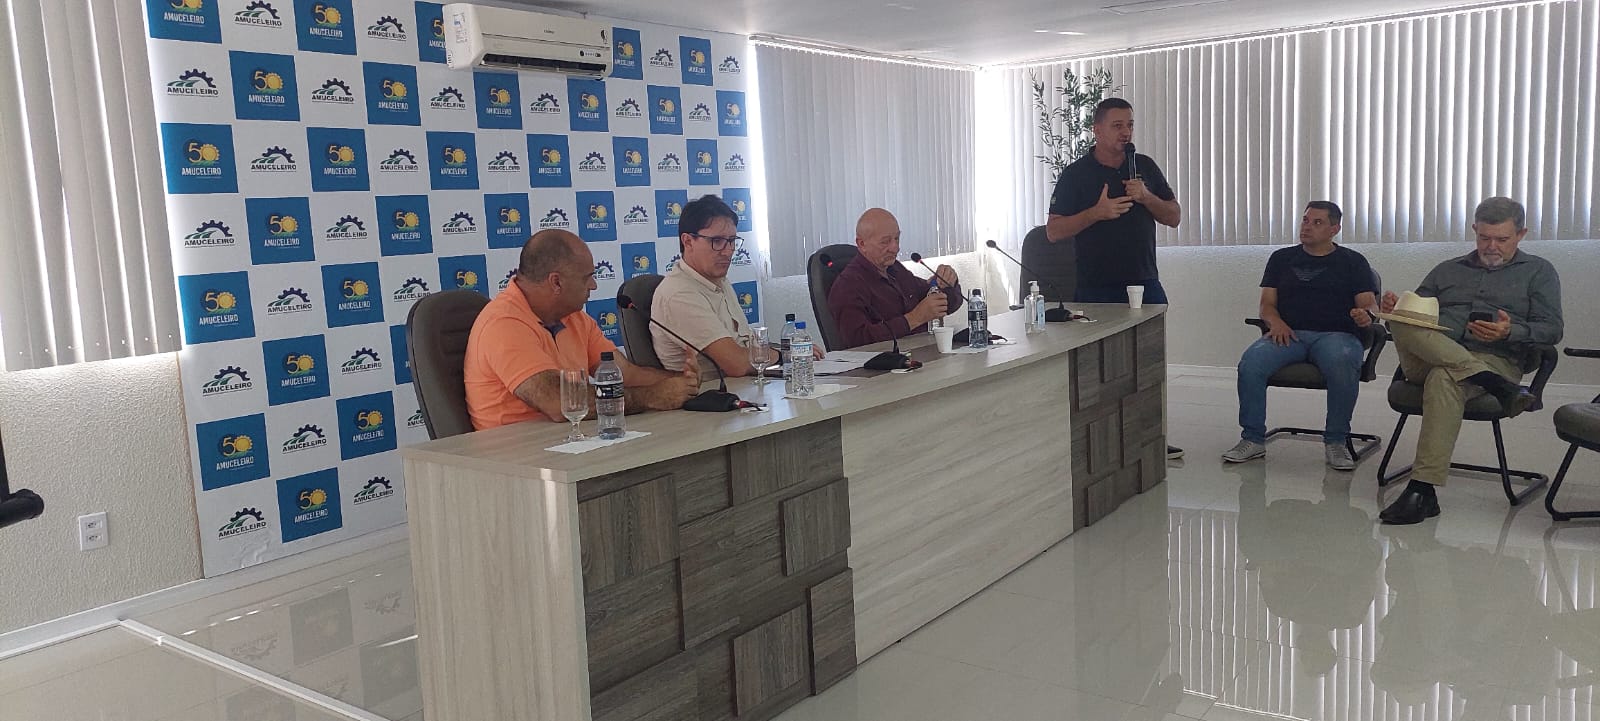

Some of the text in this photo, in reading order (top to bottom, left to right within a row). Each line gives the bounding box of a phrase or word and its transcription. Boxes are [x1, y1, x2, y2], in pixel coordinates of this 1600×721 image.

[164, 12, 204, 24] AMUCELEIRO
[235, 16, 282, 26] AMUCELEIRO
[310, 27, 342, 38] AMUCELEIRO
[368, 30, 406, 40] AMUCELEIRO
[168, 87, 218, 95] AMUCELEIRO
[248, 94, 284, 103] AMUCELEIRO
[378, 102, 408, 110] AMUCELEIRO
[182, 167, 222, 176] AMUCELEIRO
[184, 238, 234, 246] AMUCELEIRO
[264, 238, 300, 246] AMUCELEIRO
[268, 304, 312, 313] AMUCELEIRO
[338, 301, 370, 310] AMUCELEIRO
[200, 315, 238, 325] AMUCELEIRO
[342, 362, 382, 372] AMUCELEIRO
[281, 376, 316, 386] AMUCELEIRO
[202, 382, 252, 394] AMUCELEIRO
[352, 430, 384, 443] AMUCELEIRO
[282, 438, 327, 452] AMUCELEIRO
[216, 456, 254, 470] AMUCELEIRO
[354, 489, 394, 504] AMUCELEIRO
[294, 508, 328, 524] AMUCELEIRO
[218, 520, 266, 538] AMUCELEIRO
